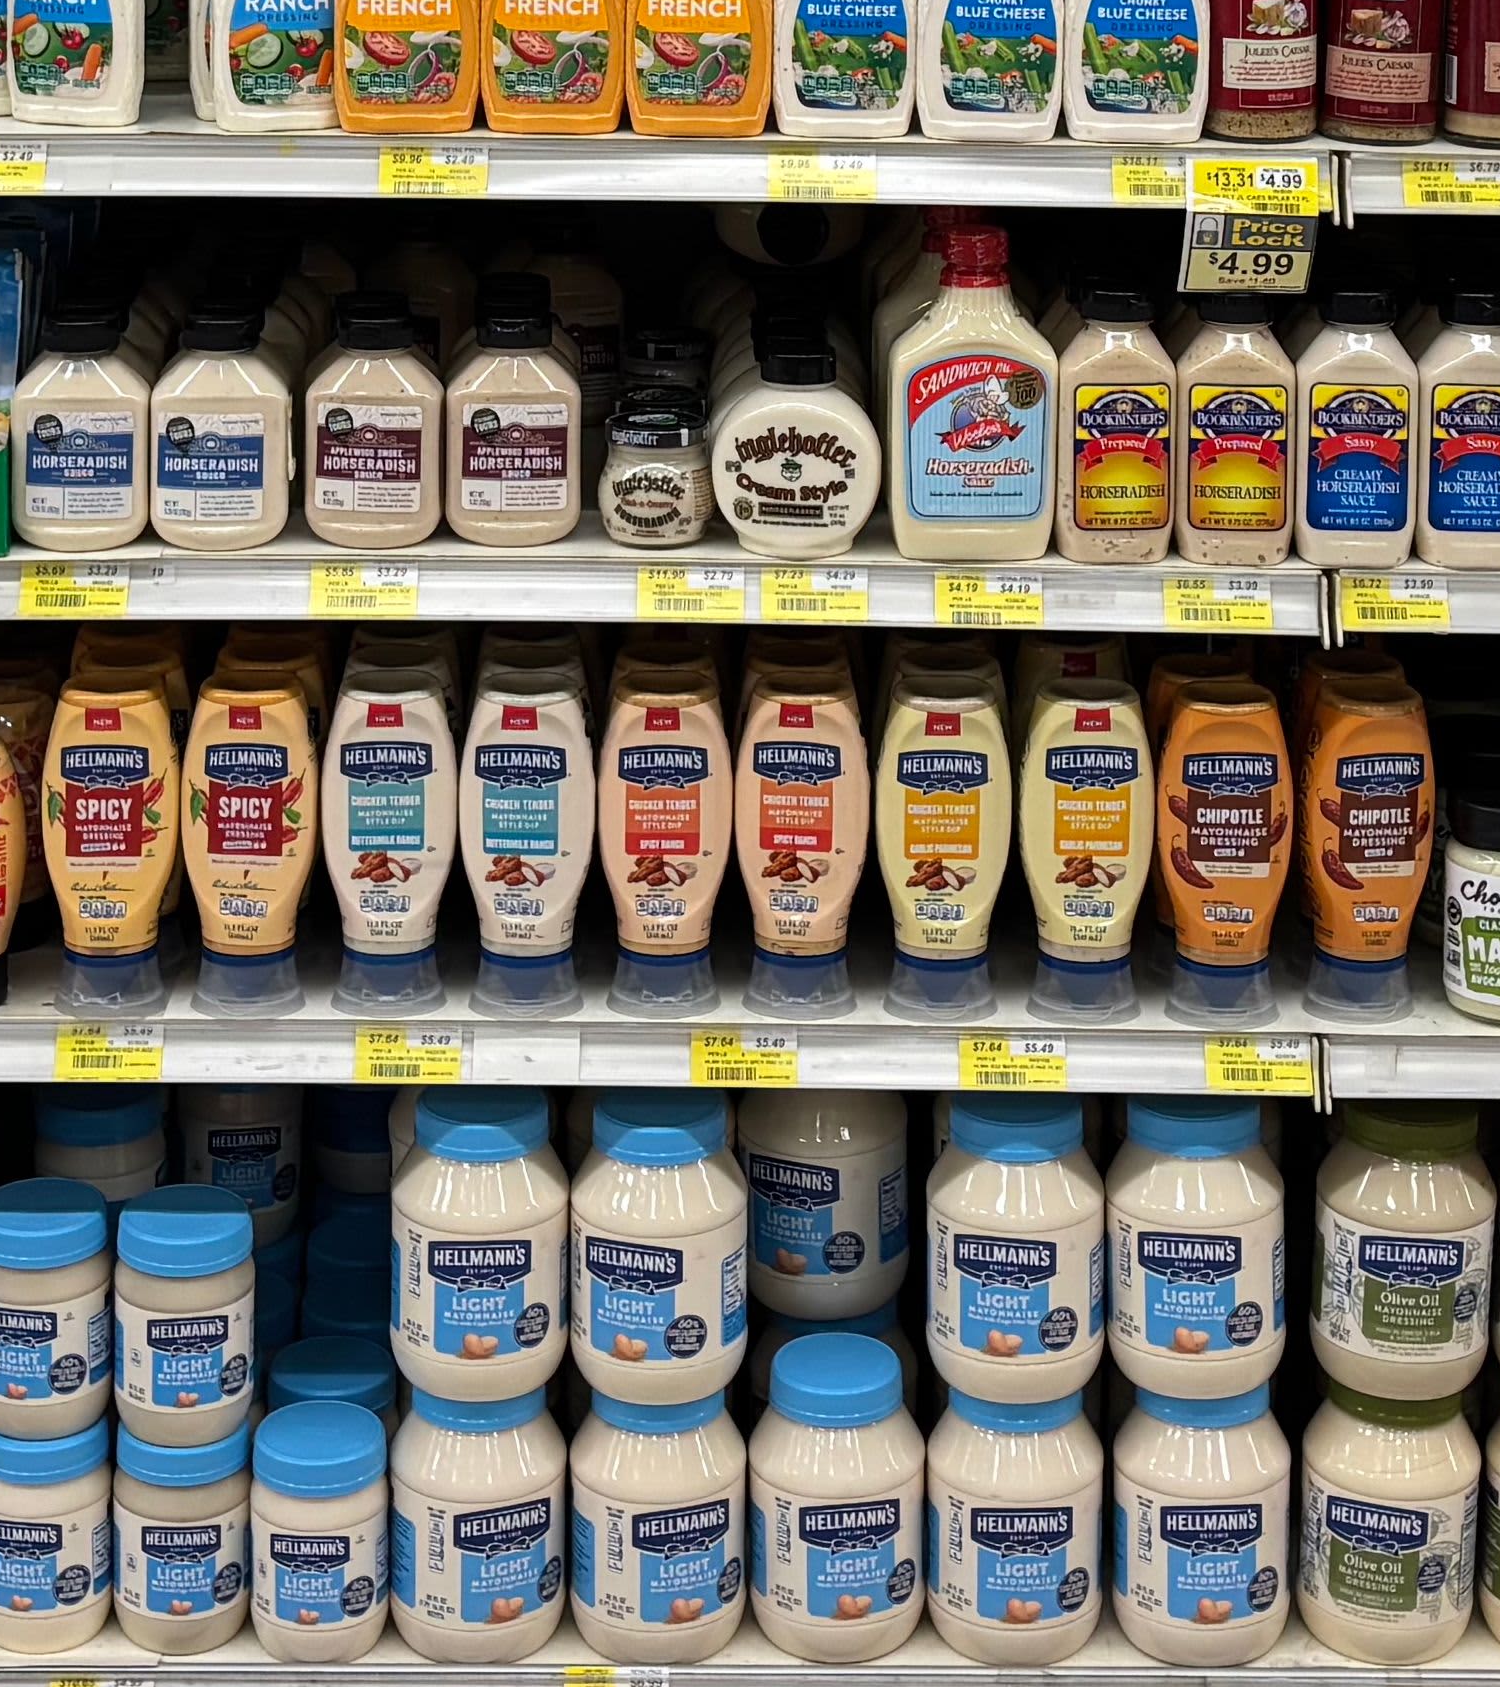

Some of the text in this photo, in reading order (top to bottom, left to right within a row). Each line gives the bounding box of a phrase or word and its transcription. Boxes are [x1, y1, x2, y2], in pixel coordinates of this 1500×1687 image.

[1206, 171, 1254, 188] $13.31
[1260, 173, 1303, 188] $4.99
[1231, 218, 1304, 235] Price
[1209, 252, 1294, 275] $4.99
[916, 360, 992, 404] SANDWICH
[1345, 436, 1377, 450] Sassy
[32, 454, 127, 471] HORSERADISH
[925, 457, 1029, 477] Horseradish
[1316, 481, 1399, 494] HORSERADISH
[1340, 494, 1375, 506] SAUCE
[948, 582, 978, 593] $4.19
[65, 750, 144, 770] HELLMANN'S
[76, 798, 133, 820] SPICY
[1196, 808, 1263, 825] CHIPOTLE
[1364, 1243, 1459, 1267] HELLMANN'S
[452, 1295, 505, 1312] LIGHT
[1380, 1292, 1441, 1308] Olive Oil
